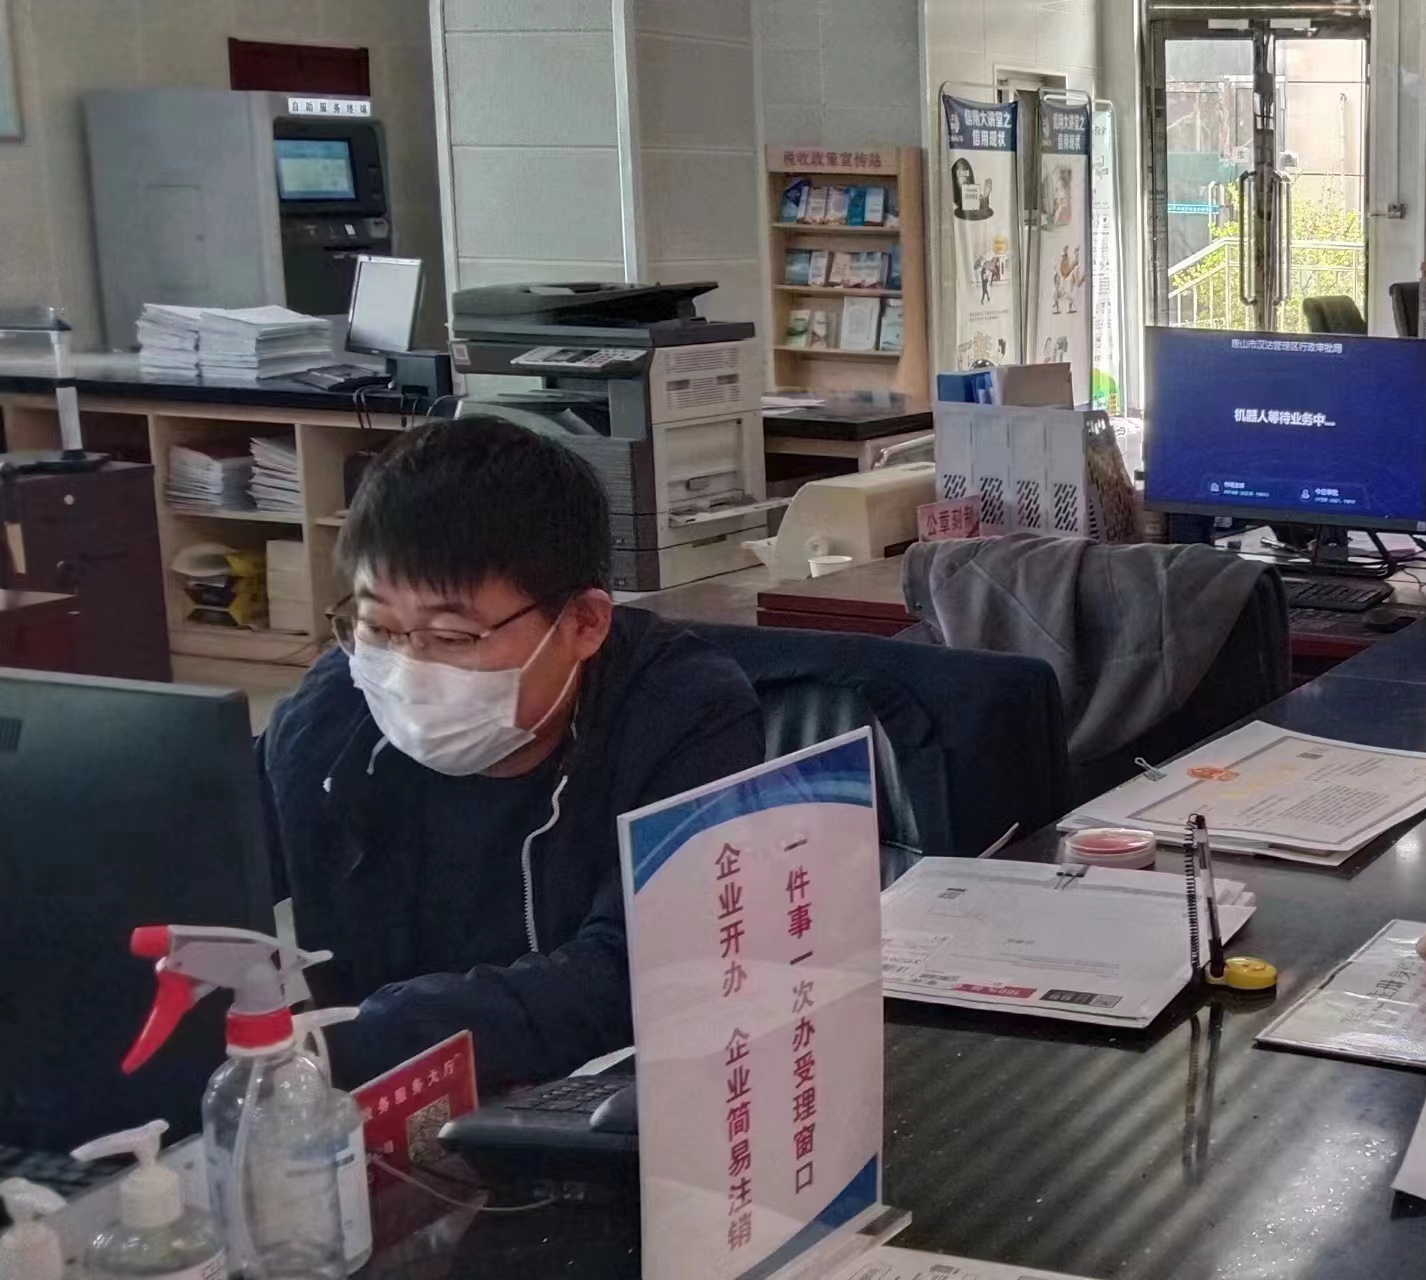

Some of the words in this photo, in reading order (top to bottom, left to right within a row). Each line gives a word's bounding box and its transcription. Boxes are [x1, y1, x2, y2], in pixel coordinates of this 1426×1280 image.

[292, 101, 368, 115] 自助服务终端
[783, 150, 882, 168] 税收政策宣传站
[714, 841, 747, 998] 企业开办
[783, 838, 817, 1194] 一件事一次办受理窗口
[724, 1026, 753, 1253] 企业简易注销
